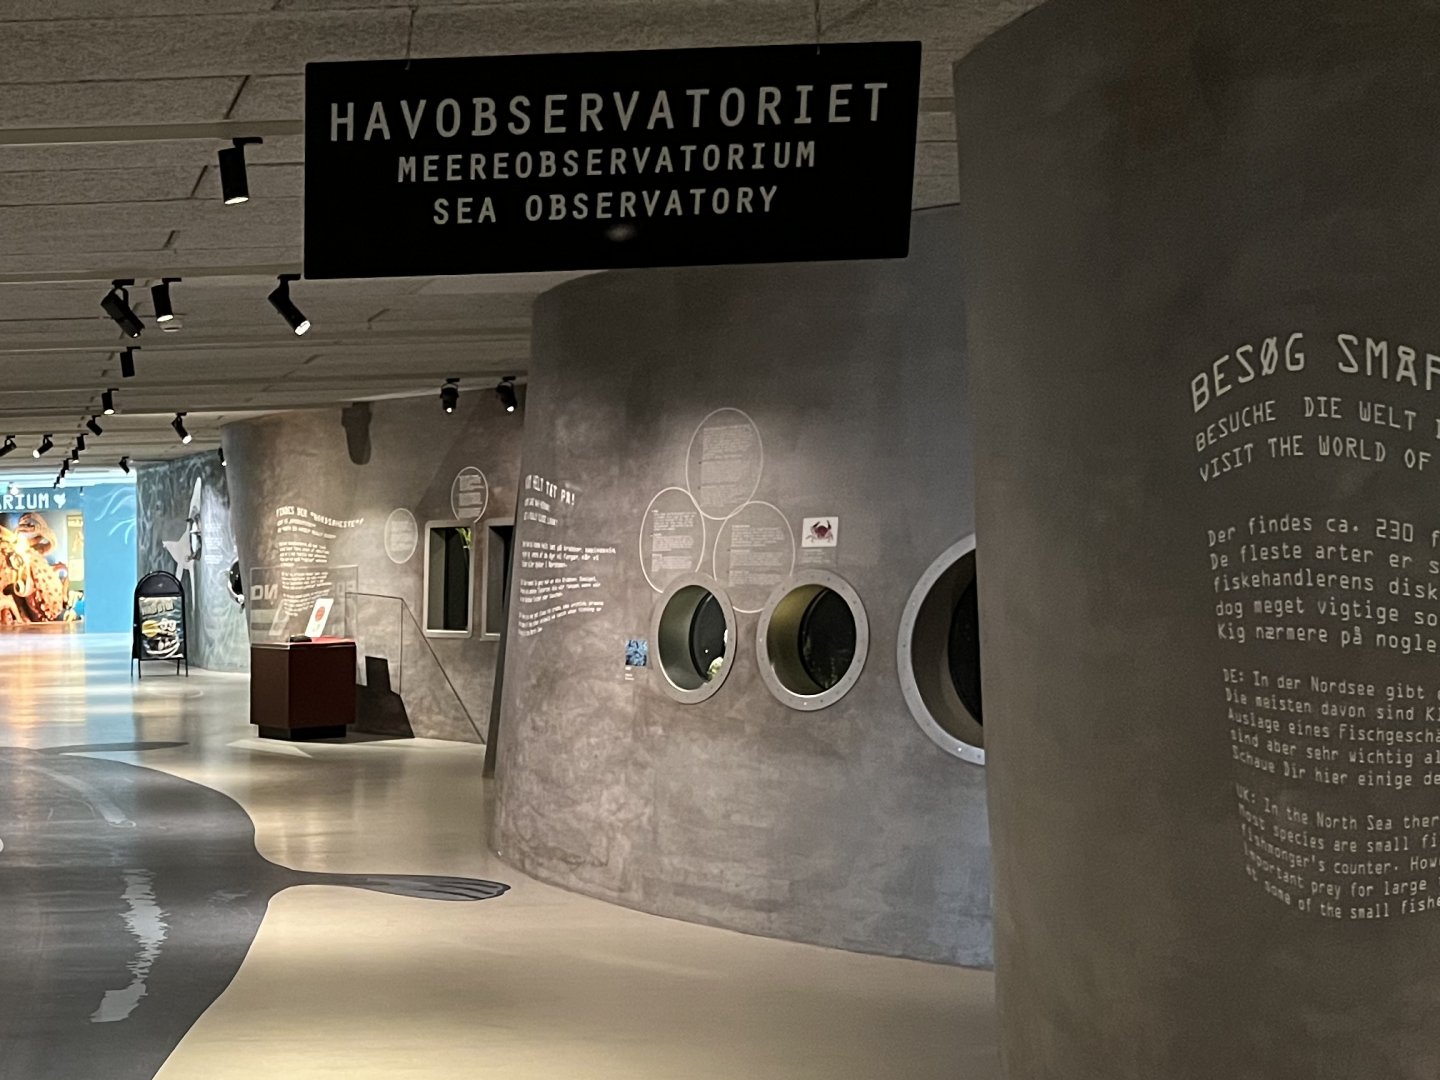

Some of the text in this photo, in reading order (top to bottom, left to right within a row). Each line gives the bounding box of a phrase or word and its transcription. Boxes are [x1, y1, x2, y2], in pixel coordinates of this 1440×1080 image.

[330, 82, 888, 142] HAVOBSERVATORIET
[398, 141, 816, 183] MEEREOBSERVATORIUM
[433, 186, 778, 225] SEA OBSERVATORY
[1191, 333, 1305, 413] BESØG
[1196, 397, 1417, 451] BESUCHE DIE WELT
[1200, 435, 1431, 482] VISIT THE WORLD OF
[1208, 527, 1235, 546] Der
[1249, 515, 1312, 535] findes
[1326, 518, 1359, 532] ca.
[1376, 519, 1413, 542] 230
[1210, 553, 1228, 570] De
[1241, 542, 1302, 563] fleste
[1315, 544, 1373, 563] arter
[1389, 553, 1412, 568] er
[1214, 569, 1438, 600] fiskehandlerens disk
[1216, 597, 1438, 627] dog meget vigtige so
[1218, 622, 1436, 654] Kig nærmere på nogle
[1223, 668, 1424, 701] DE: In der Nordsee gibt
[1225, 688, 1247, 705] Die
[1256, 695, 1311, 713] meisten
[1322, 701, 1365, 718] davon
[1377, 705, 1414, 721] sind
[1228, 707, 1280, 733] Auslage
[1289, 720, 1329, 738] eines
[1232, 745, 1275, 773] Schaue
[1283, 761, 1305, 779] Dir
[1314, 769, 1348, 784] hier
[1358, 771, 1412, 790] einige
[1267, 740, 1296, 755] aber
[1307, 746, 1338, 761] sehr
[1349, 749, 1413, 768] wichtig
[1264, 798, 1278, 815] In
[1287, 806, 1308, 824] the
[1317, 812, 1357, 830] North
[1367, 815, 1392, 830] Sea
[1404, 816, 1439, 829] ther
[1241, 824, 1440, 875] fishmonger's counter. How
[1273, 825, 1324, 849] species
[1334, 841, 1357, 852] are
[1367, 837, 1408, 852] small
[1311, 881, 1340, 899] prey
[1351, 882, 1373, 897] for
[1384, 880, 1427, 895] large
[1299, 898, 1311, 912] of
[1321, 903, 1341, 918] the
[1350, 903, 1389, 919] small
